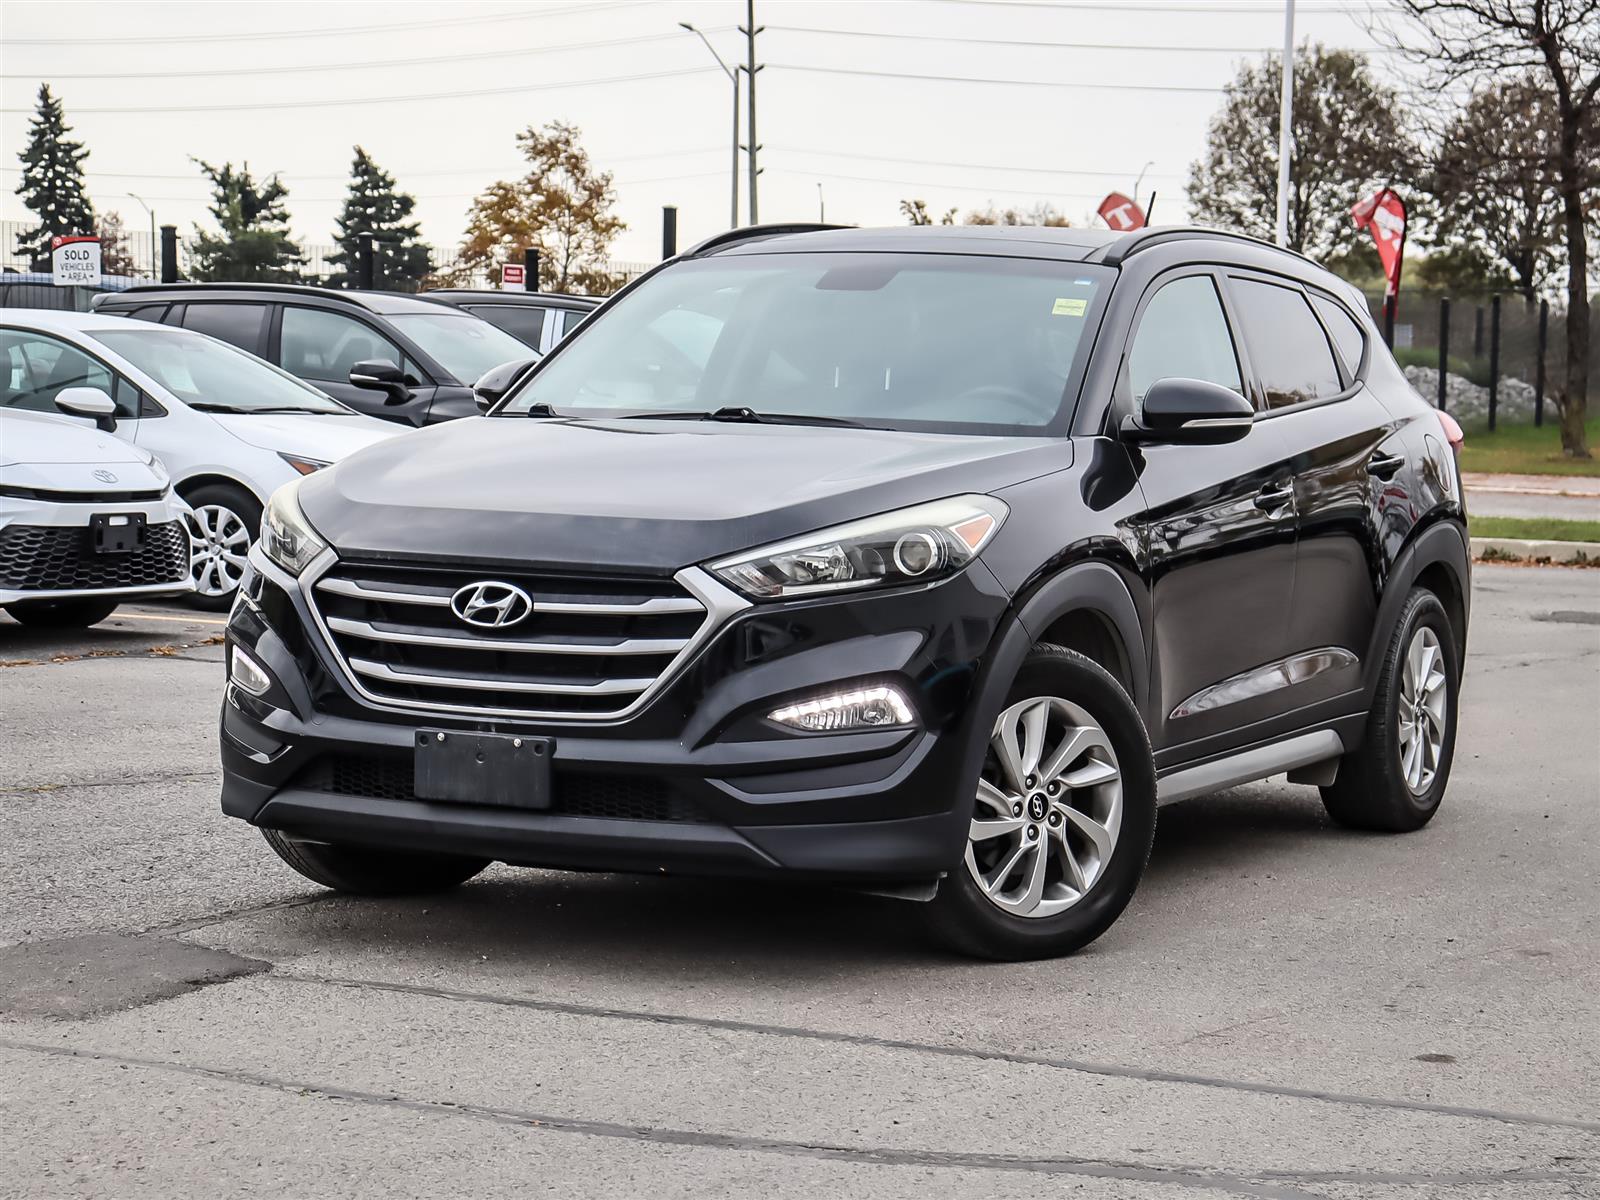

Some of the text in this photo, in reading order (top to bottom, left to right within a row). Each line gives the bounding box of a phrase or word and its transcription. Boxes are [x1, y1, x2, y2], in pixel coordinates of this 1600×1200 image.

[64, 250, 90, 260] SOLD
[60, 262, 95, 271] VEHICLES
[68, 272, 88, 281] AREA
